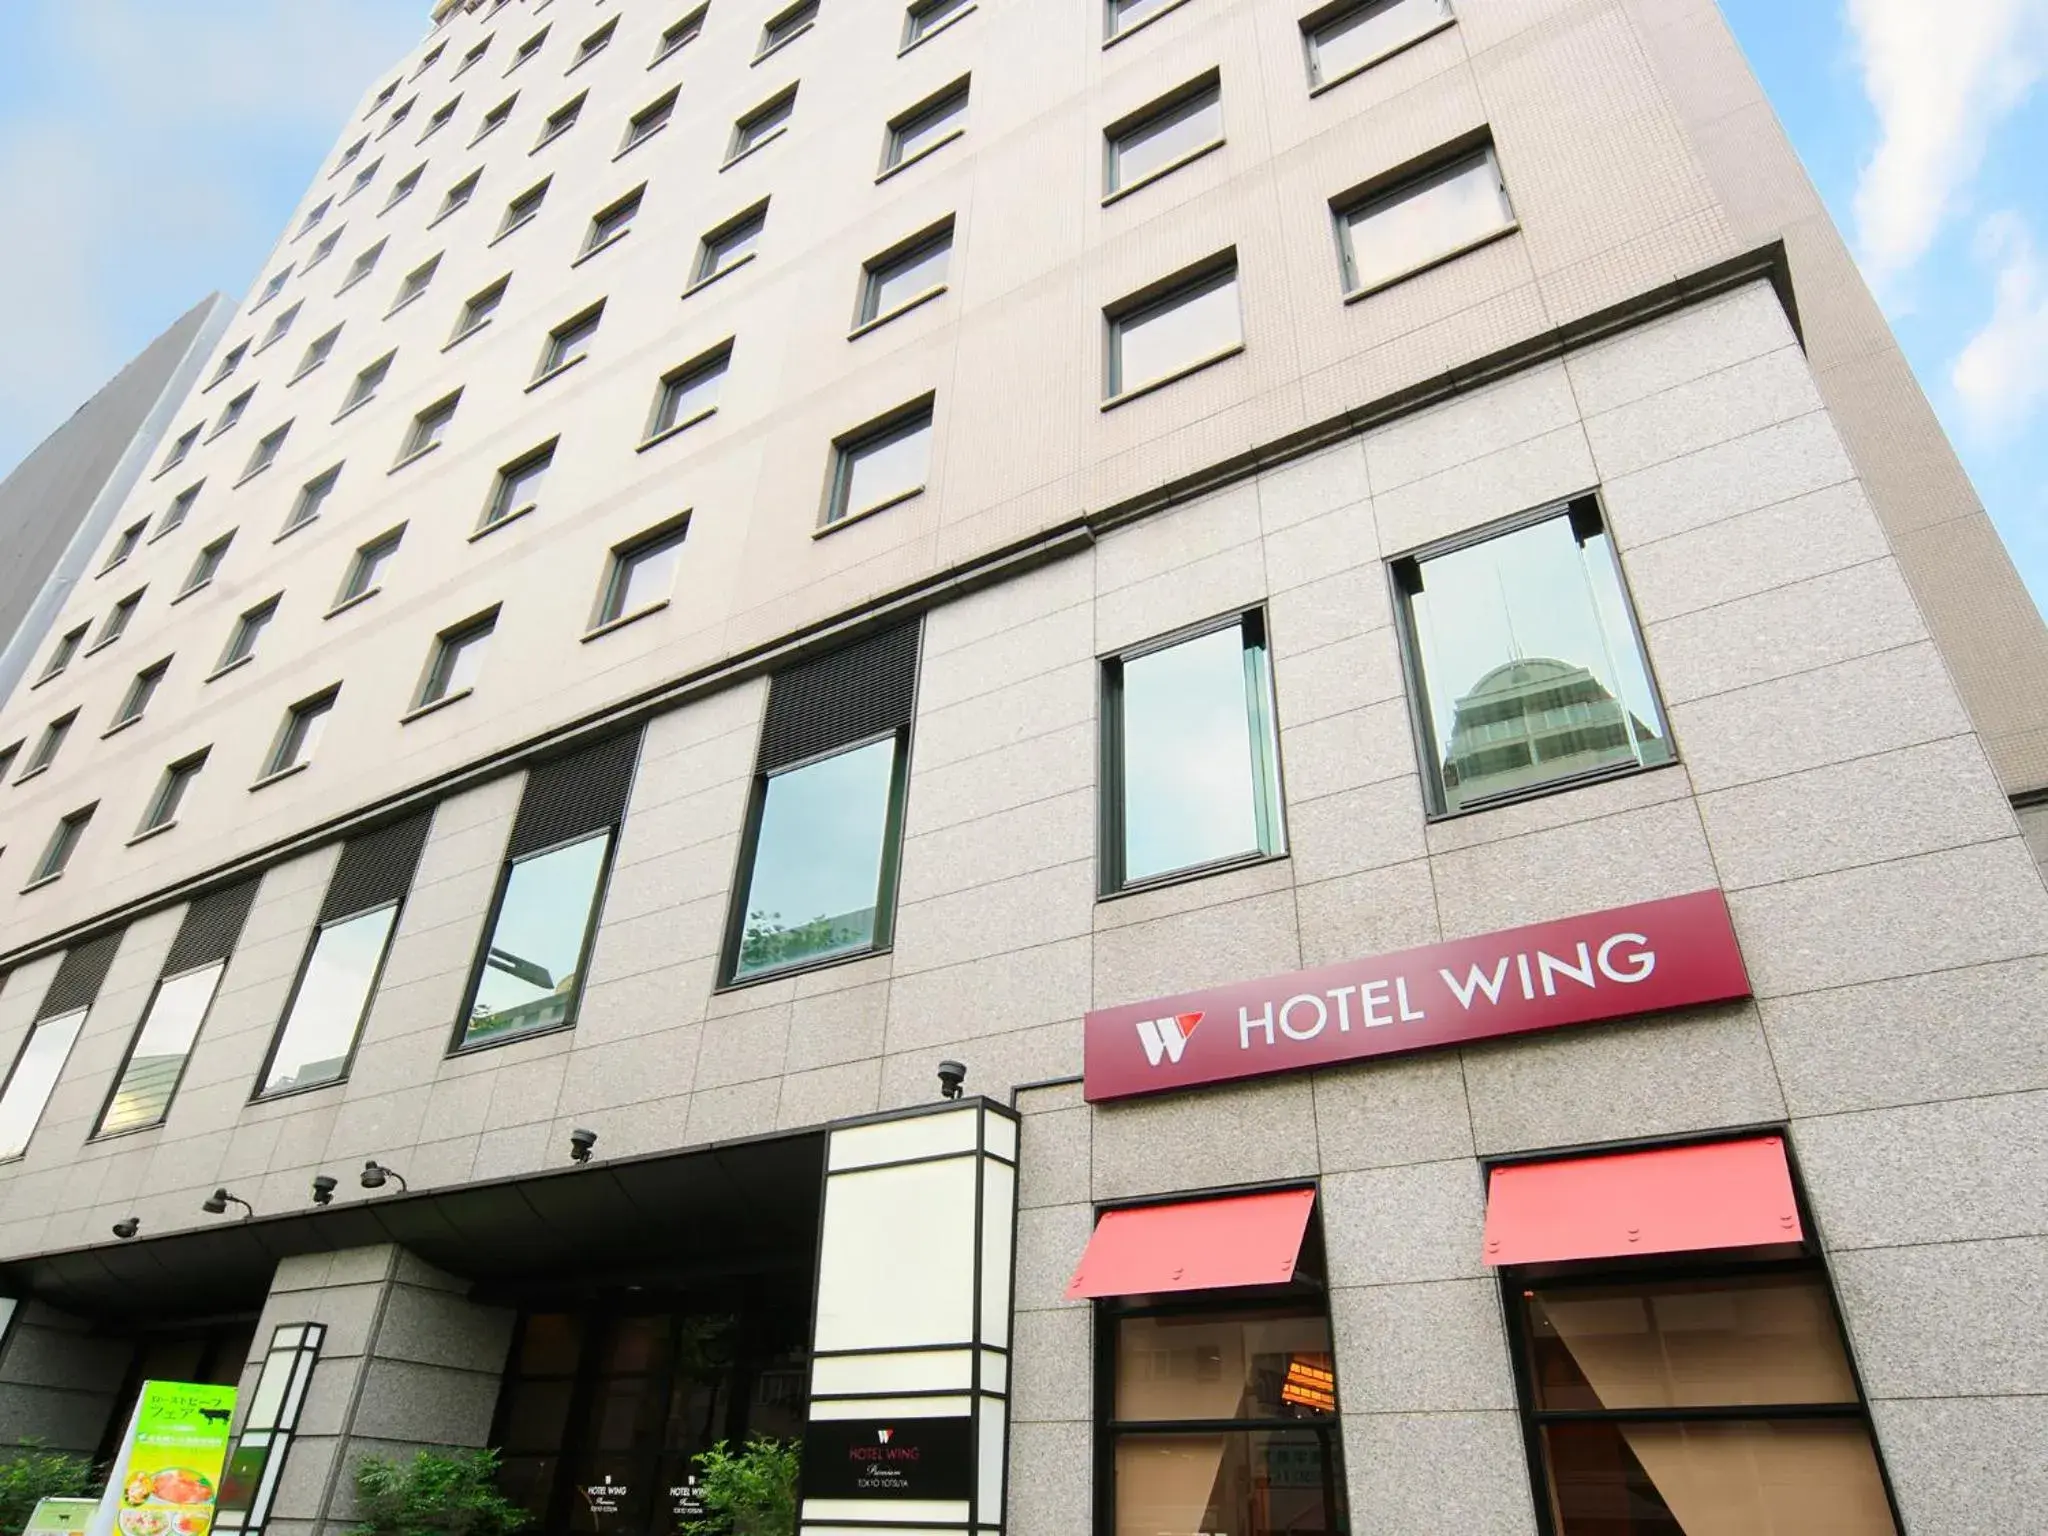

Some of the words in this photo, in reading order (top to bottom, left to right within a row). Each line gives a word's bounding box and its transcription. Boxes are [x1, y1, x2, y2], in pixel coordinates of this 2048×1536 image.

[1238, 977, 1426, 1049] HOTEL
[1439, 932, 1656, 1010] WING
[850, 1447, 883, 1460] HOTEL
[887, 1446, 920, 1459] WING
[587, 1486, 606, 1495] HOTEL
[608, 1486, 627, 1495] WING
[670, 1487, 690, 1496] HOTEL
